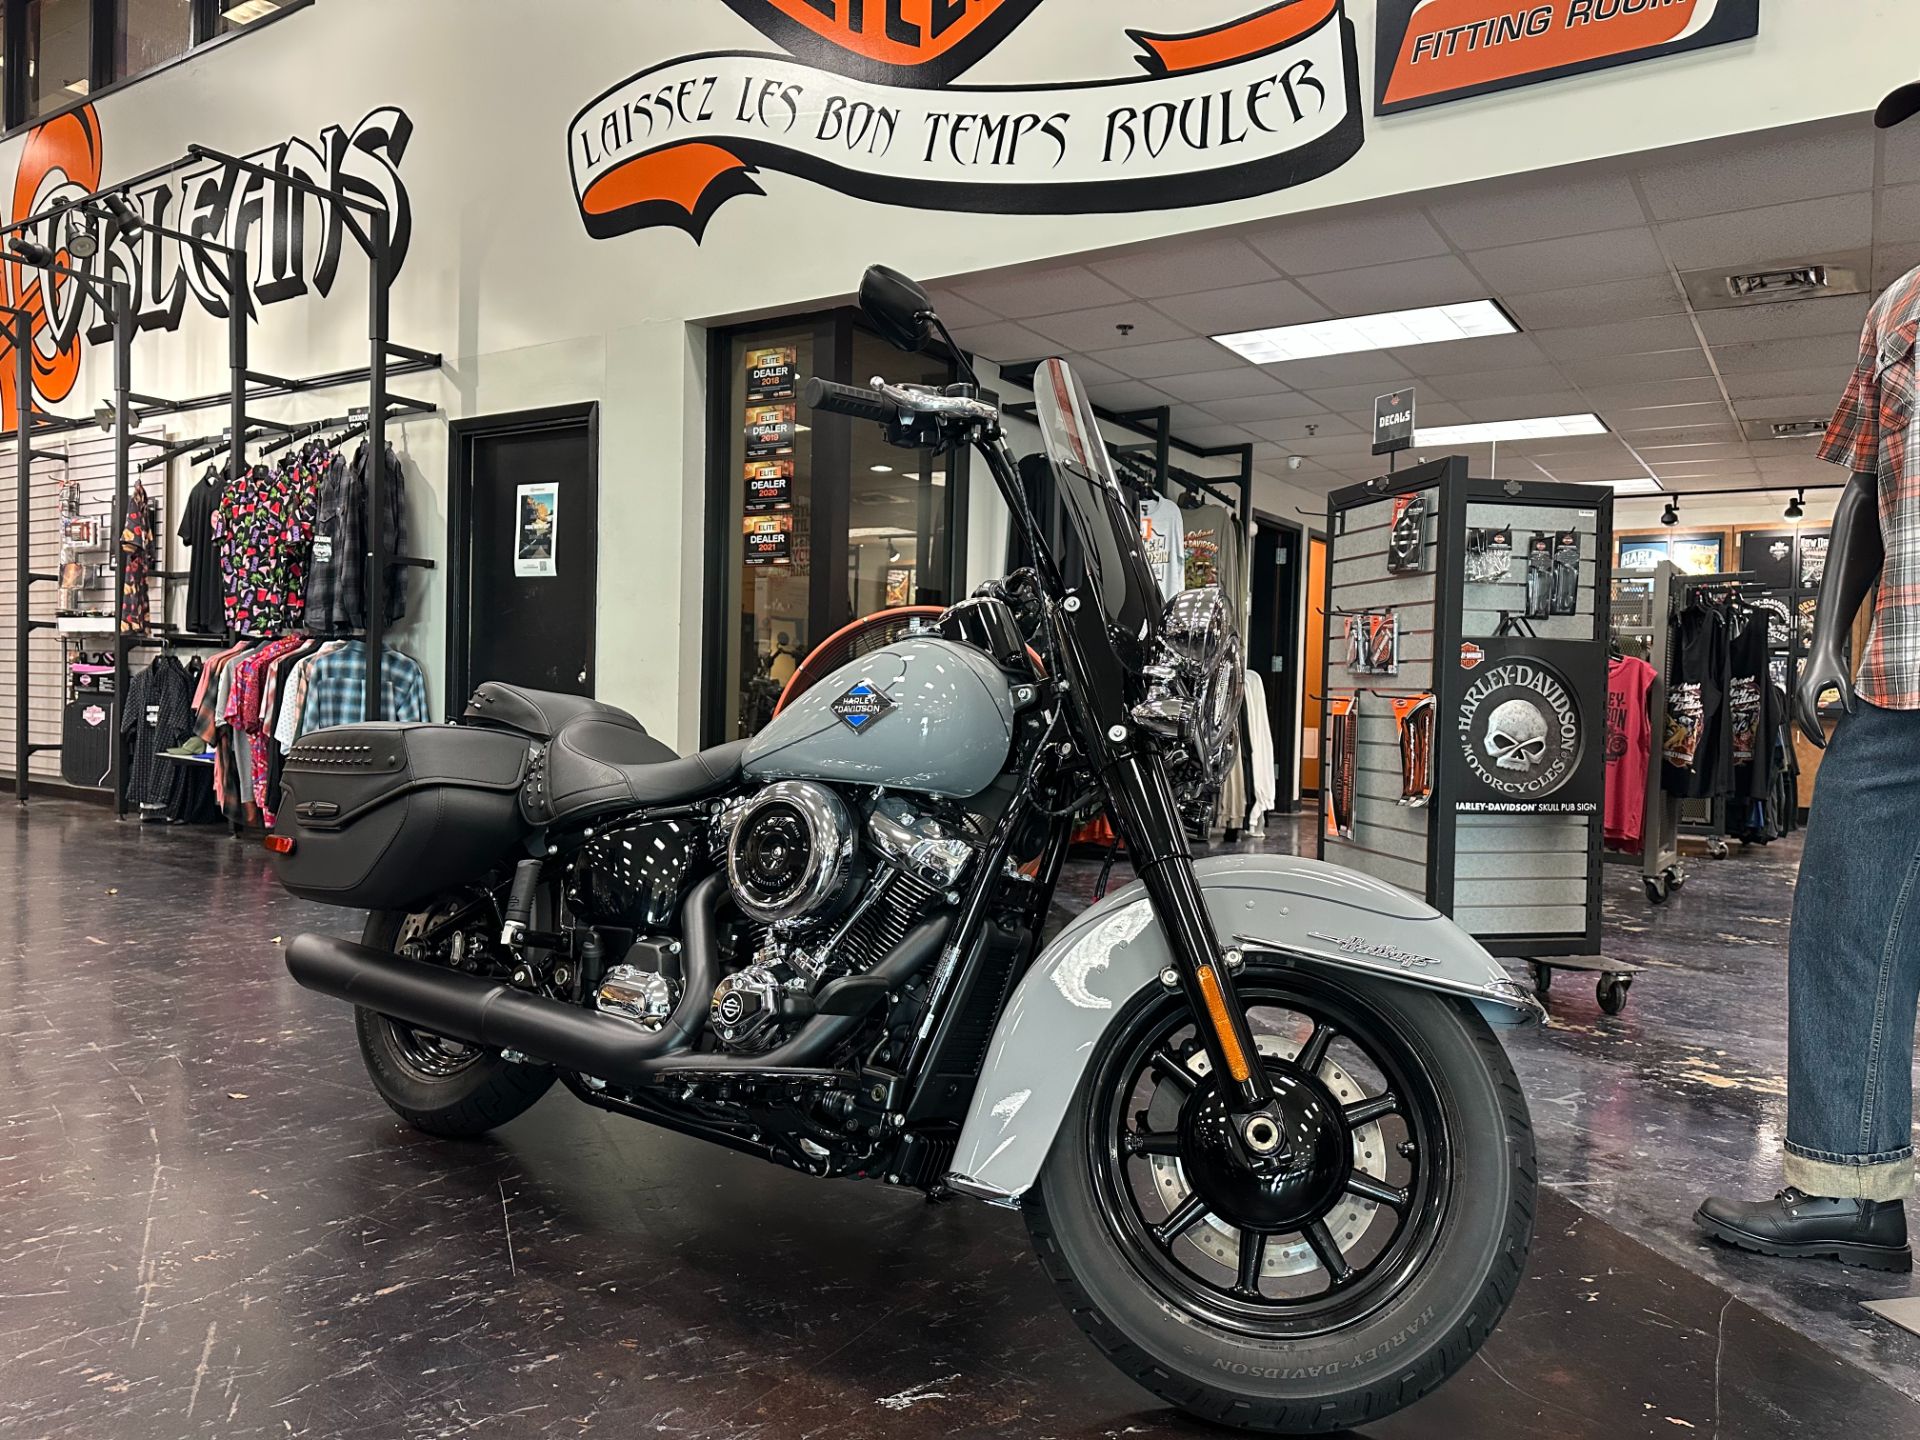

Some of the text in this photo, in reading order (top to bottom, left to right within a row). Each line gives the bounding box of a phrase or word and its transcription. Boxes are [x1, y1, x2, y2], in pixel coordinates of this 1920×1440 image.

[1410, 5, 1552, 64] FITTING
[580, 58, 1326, 169] LAISSEZ LES BON TEMPS ROULER
[761, 356, 780, 366] ELITE
[753, 366, 789, 379] DEALER
[760, 413, 780, 422] ELITE
[1379, 409, 1411, 428] DECALS
[752, 423, 788, 436] DEALER
[759, 469, 778, 477] ELITE
[751, 479, 786, 490] DEALER
[758, 488, 778, 497] 2020
[750, 533, 785, 544] DEALER
[758, 543, 776, 551] 2021
[842, 695, 878, 705] HARLEY-
[838, 704, 880, 713] DAVIDSON
[1458, 664, 1577, 752] HARLEY-DAVIDSON
[1461, 743, 1566, 793] MOTORCYCLES
[1538, 803, 1560, 812] SKULL
[1561, 803, 1576, 811] PUB
[1576, 802, 1597, 811] SIGN
[1212, 1304, 1436, 1380] HARLEY-DAVIDSON
